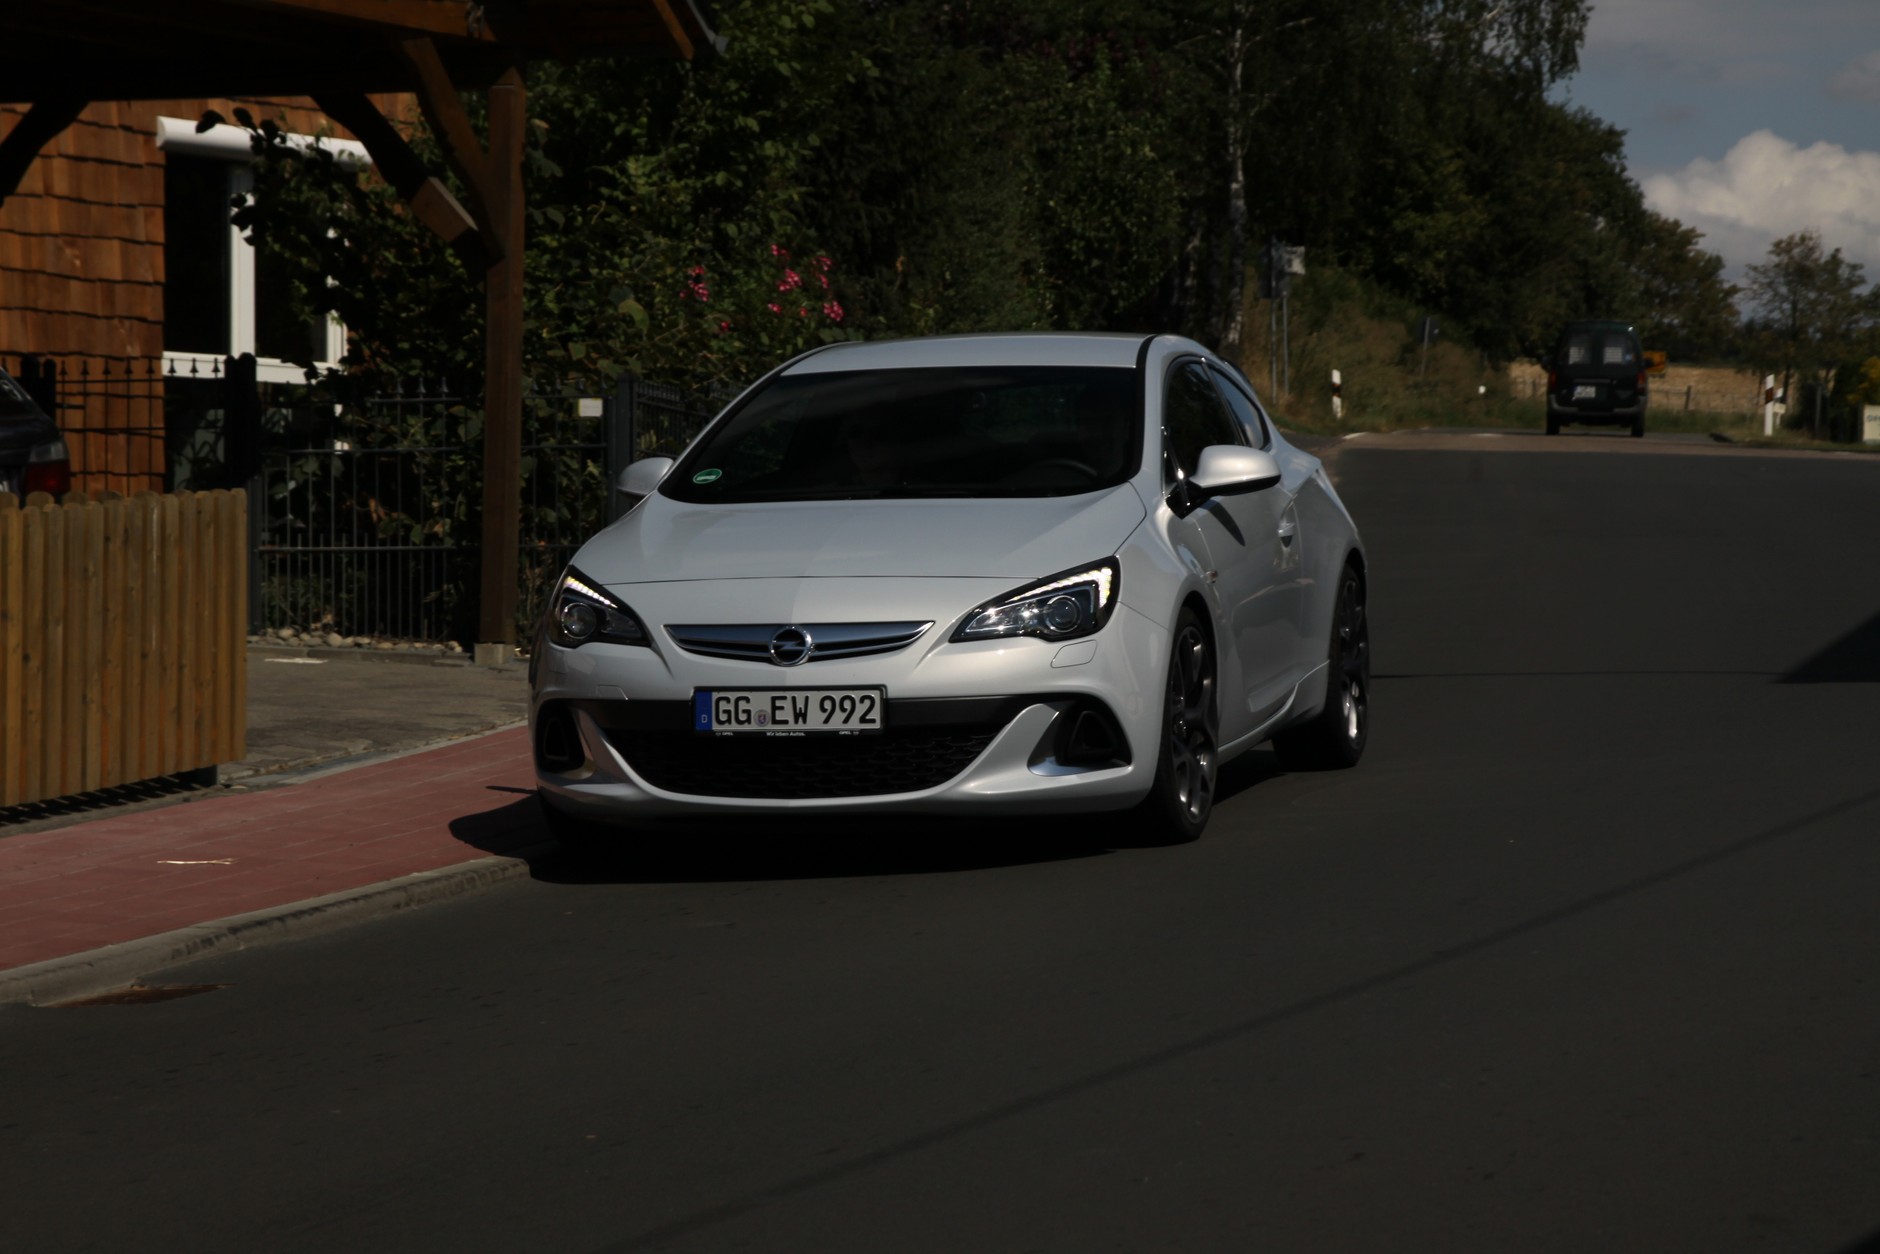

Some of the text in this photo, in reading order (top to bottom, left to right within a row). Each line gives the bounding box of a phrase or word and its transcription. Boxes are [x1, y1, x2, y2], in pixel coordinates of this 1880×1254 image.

[701, 715, 708, 723] D
[715, 694, 877, 725] GG EW 992
